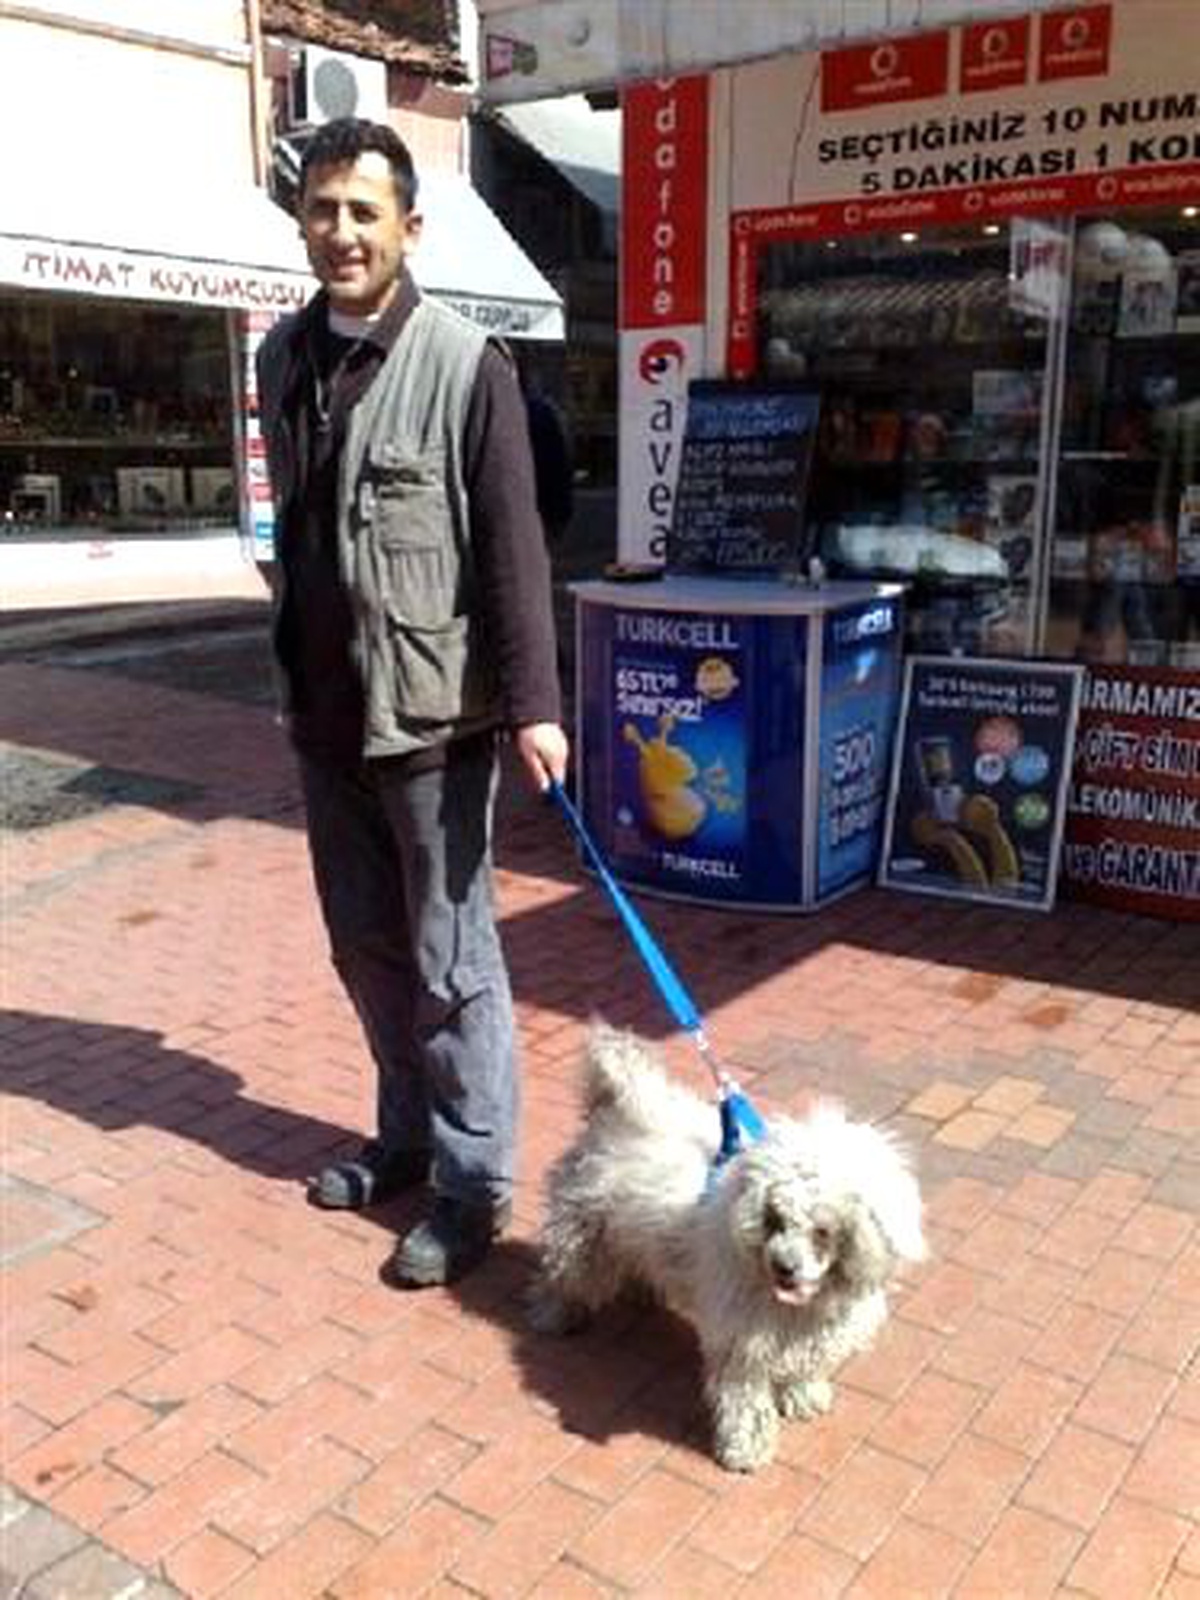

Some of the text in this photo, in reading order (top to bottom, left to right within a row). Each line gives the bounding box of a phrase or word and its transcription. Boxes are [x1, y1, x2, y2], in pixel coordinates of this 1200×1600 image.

[819, 111, 1026, 164] SEÇTİĞİNİZ
[1041, 107, 1087, 135] 10
[860, 134, 1200, 194] 5 DAKİKASI 1 KO
[615, 613, 740, 650] TURKCELL
